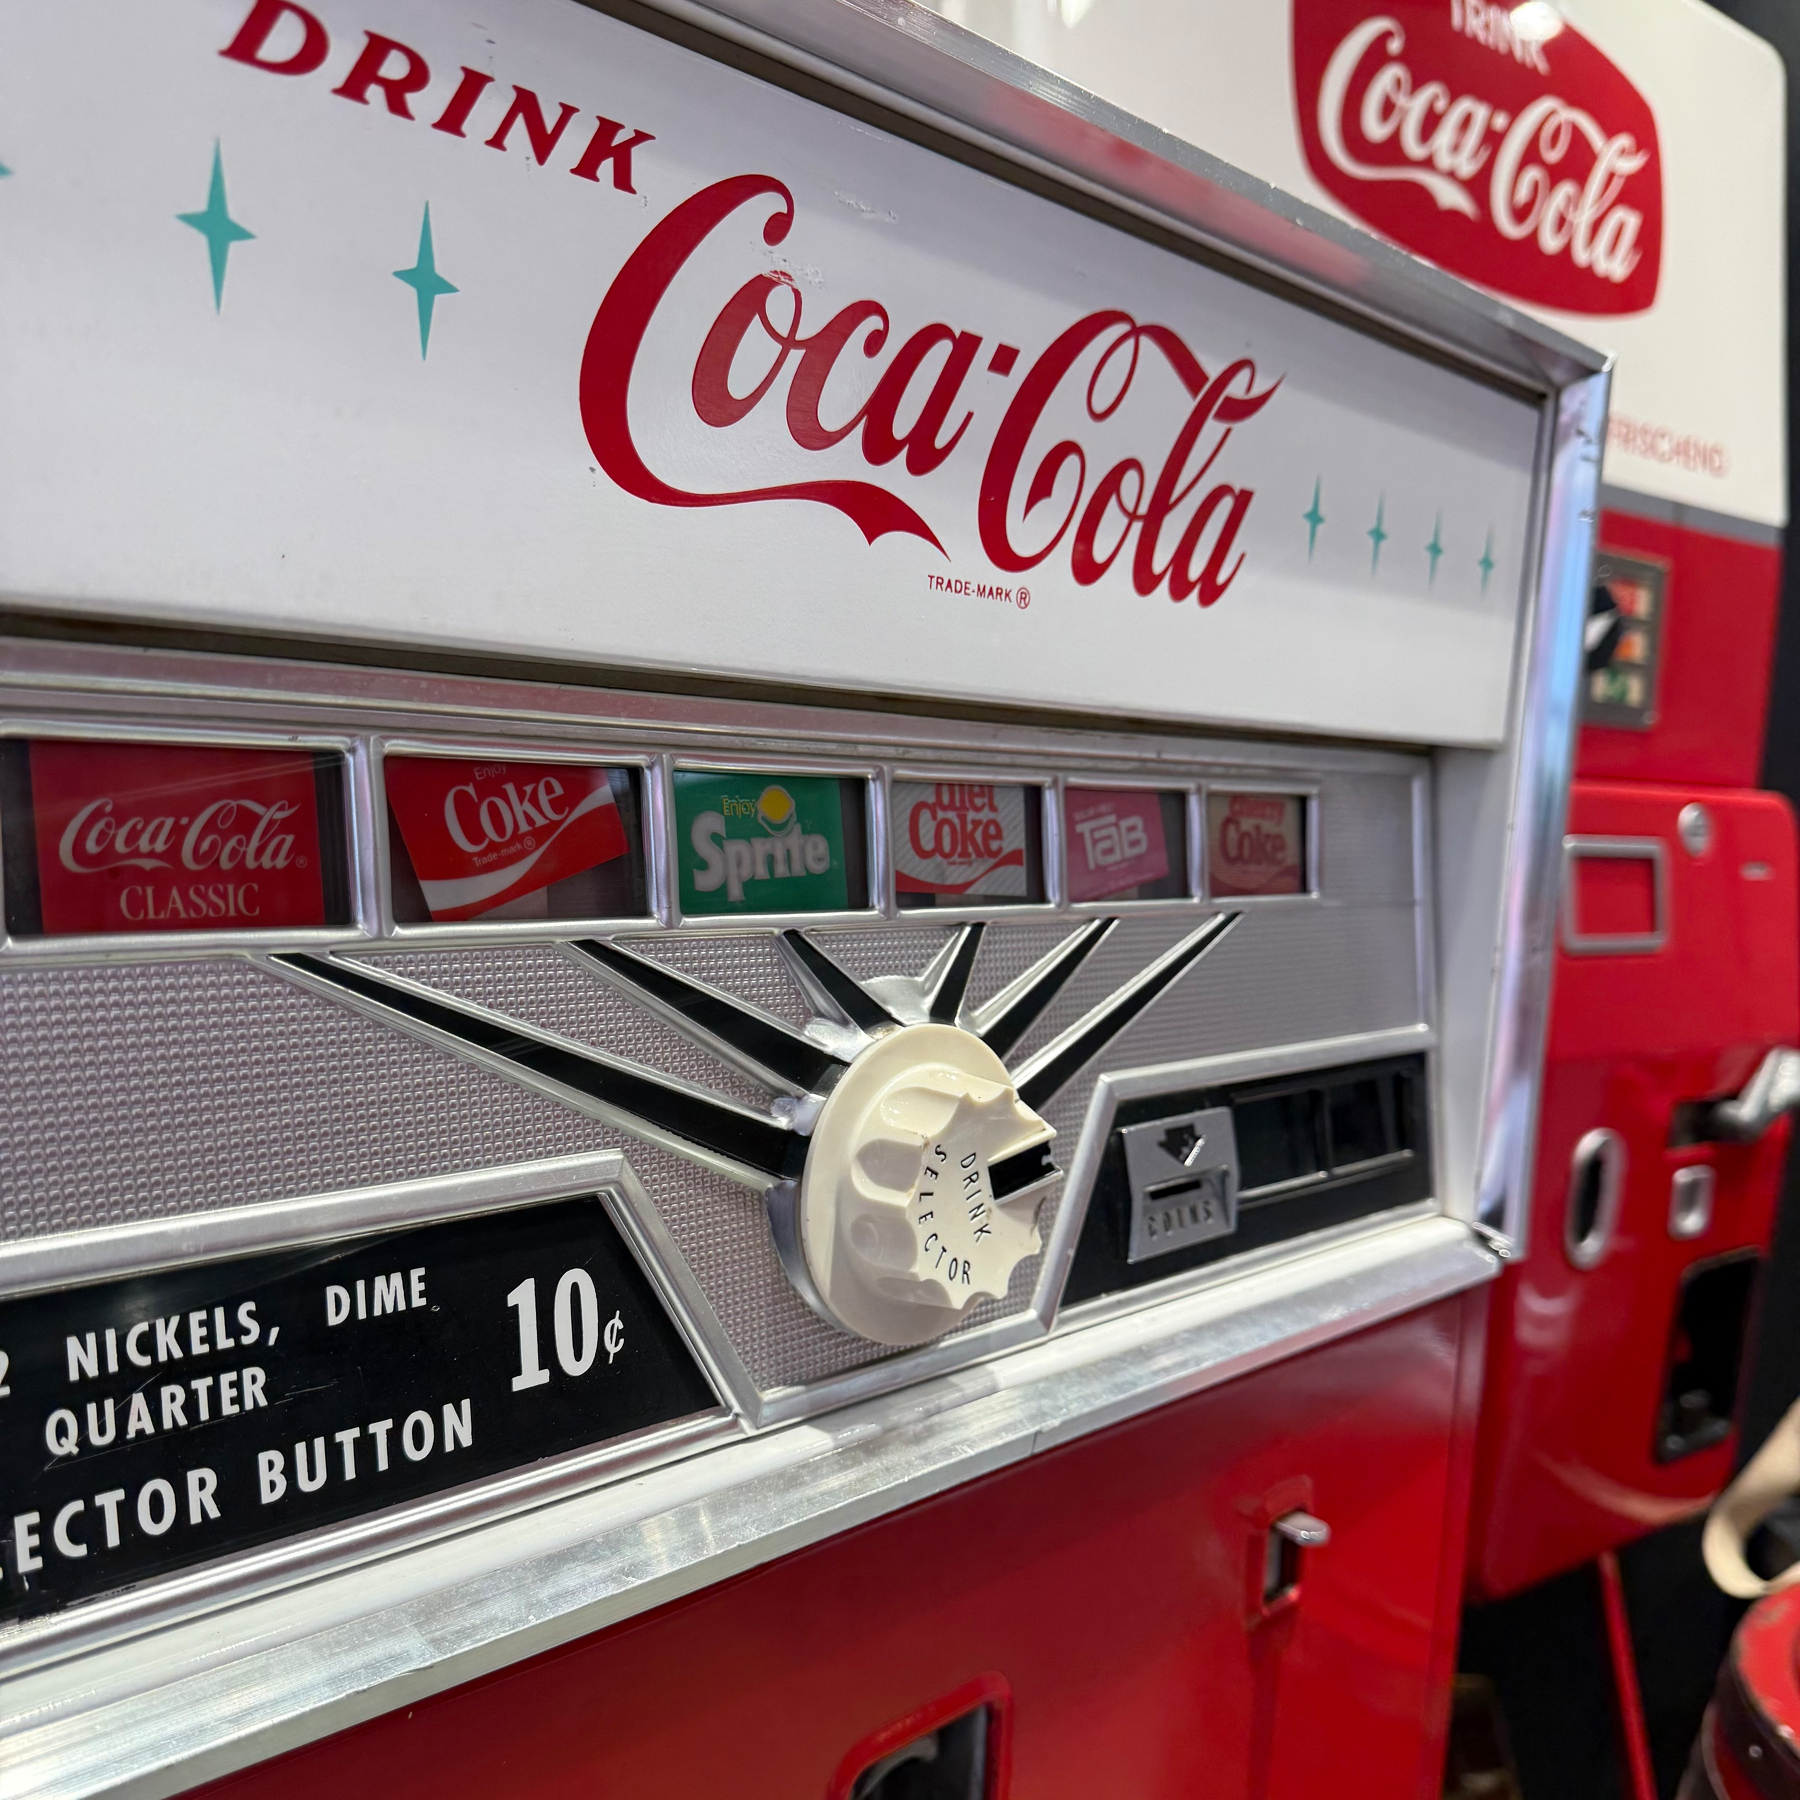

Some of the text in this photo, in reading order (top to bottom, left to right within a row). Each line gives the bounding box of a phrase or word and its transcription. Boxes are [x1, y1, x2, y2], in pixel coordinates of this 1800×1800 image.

[219, 0, 655, 195] DRINK
[1317, 16, 1650, 283] Coca-Cola
[579, 174, 1287, 608] Coca-Cola
[927, 574, 1013, 604] TRADE-MARK
[474, 763, 507, 781] Enjoy
[722, 796, 757, 818] Enjoy
[58, 798, 301, 873] Coca-Cola
[444, 776, 569, 853] Coke
[908, 800, 1004, 860] Coke
[1219, 816, 1288, 867] Coke
[472, 842, 523, 867] Trade-mark
[691, 810, 831, 902] Sprite
[119, 883, 260, 920] CLASSIC
[918, 1144, 971, 1285] SELECTOR
[960, 1152, 992, 1243] DRINK
[1148, 1200, 1213, 1240] COINS
[66, 1301, 280, 1382] NICKELS,
[326, 1267, 427, 1327] DIME
[45, 1366, 269, 1457] QUARTER
[0, 1398, 473, 1581] ECTOR BUTTON
